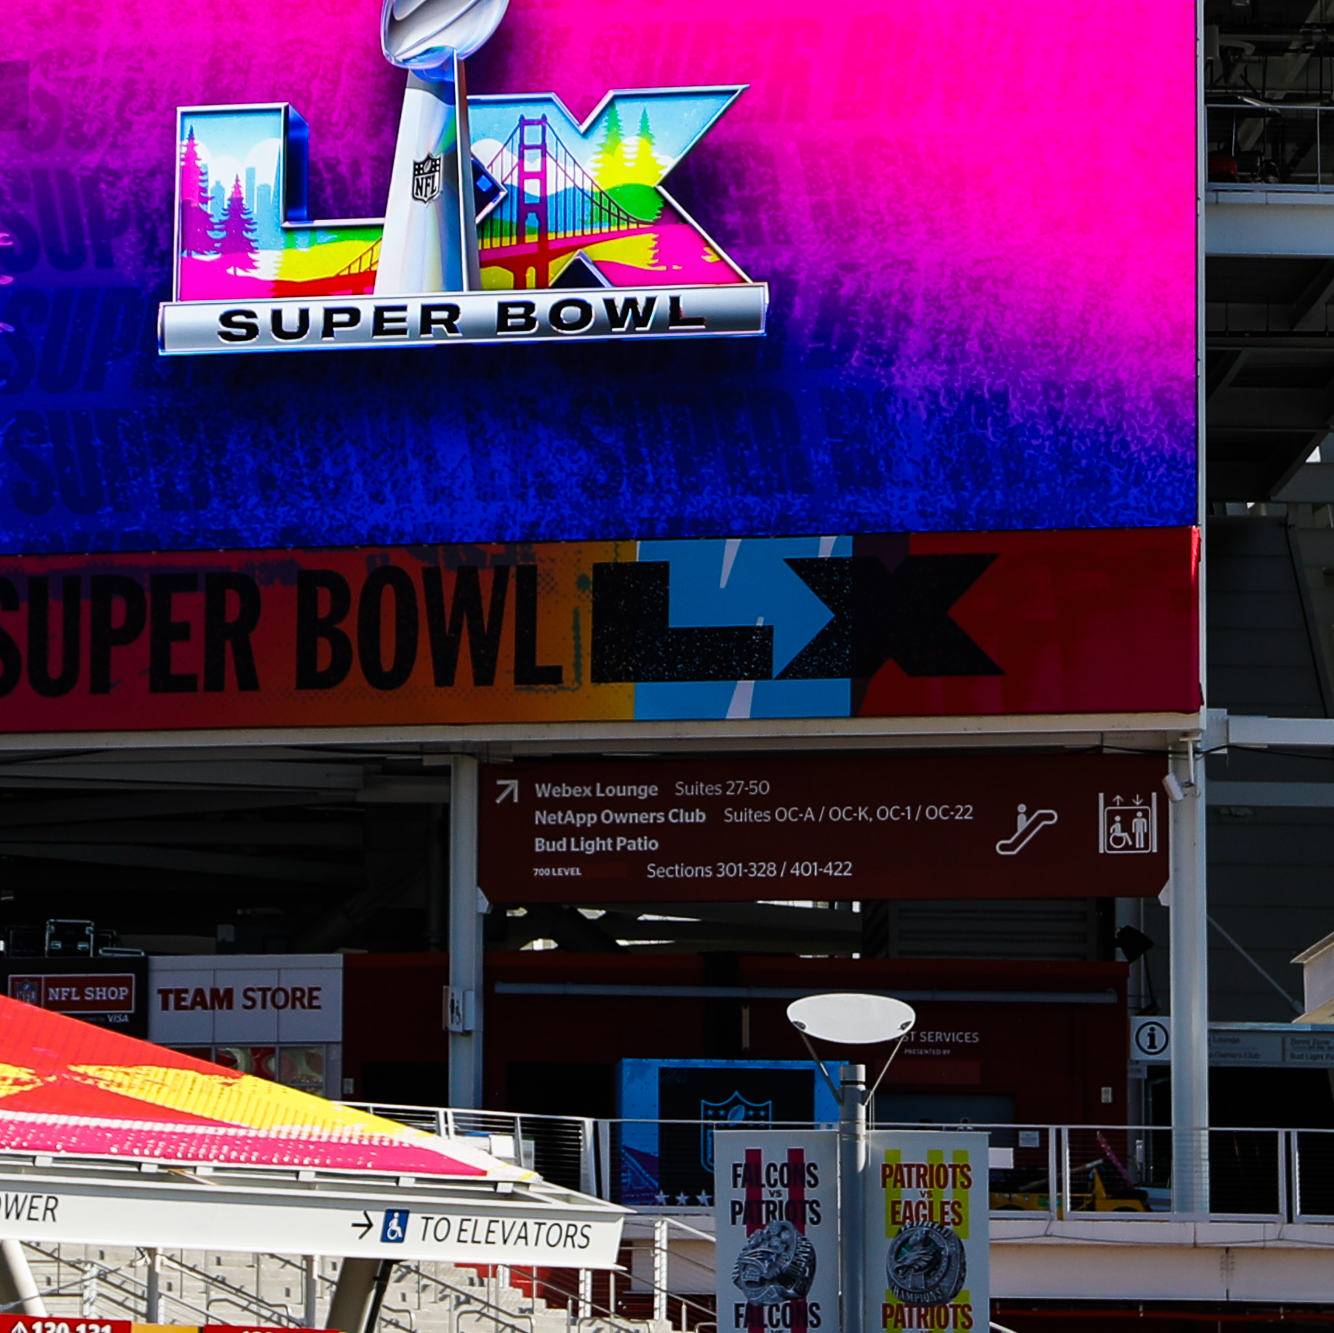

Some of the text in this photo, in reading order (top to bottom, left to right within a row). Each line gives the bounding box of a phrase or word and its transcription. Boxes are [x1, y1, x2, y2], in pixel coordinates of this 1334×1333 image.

[414, 173, 439, 201] NFL
[217, 296, 707, 343] SUPER BOWL
[295, 562, 564, 692] BOWL
[590, 552, 1007, 684] LX
[535, 780, 770, 799] Webex Lounge Suites 27-50
[535, 805, 973, 827] NetApp Owners Club Suites OC-A / OC-K, OC-1 / OC-22
[535, 836, 659, 854] Bud Light Patio
[533, 861, 852, 878] 700 LEVEL Sections 301-328 / 401-422
[48, 987, 85, 1001] NFL
[88, 987, 128, 1001] SHOP
[157, 986, 322, 1011] TEAM STORE
[107, 1014, 129, 1023] VISA
[919, 1031, 979, 1043] SERVICES
[731, 1163, 819, 1188] FALCONS
[881, 1163, 973, 1189] PATRIOTS
[731, 1199, 821, 1226] PATRIOTS
[891, 1199, 964, 1226] EAGLES
[421, 1216, 592, 1249] TO ELEVATORS
[734, 1302, 822, 1328] FALCONS
[881, 1303, 974, 1329] PATRIOTS
